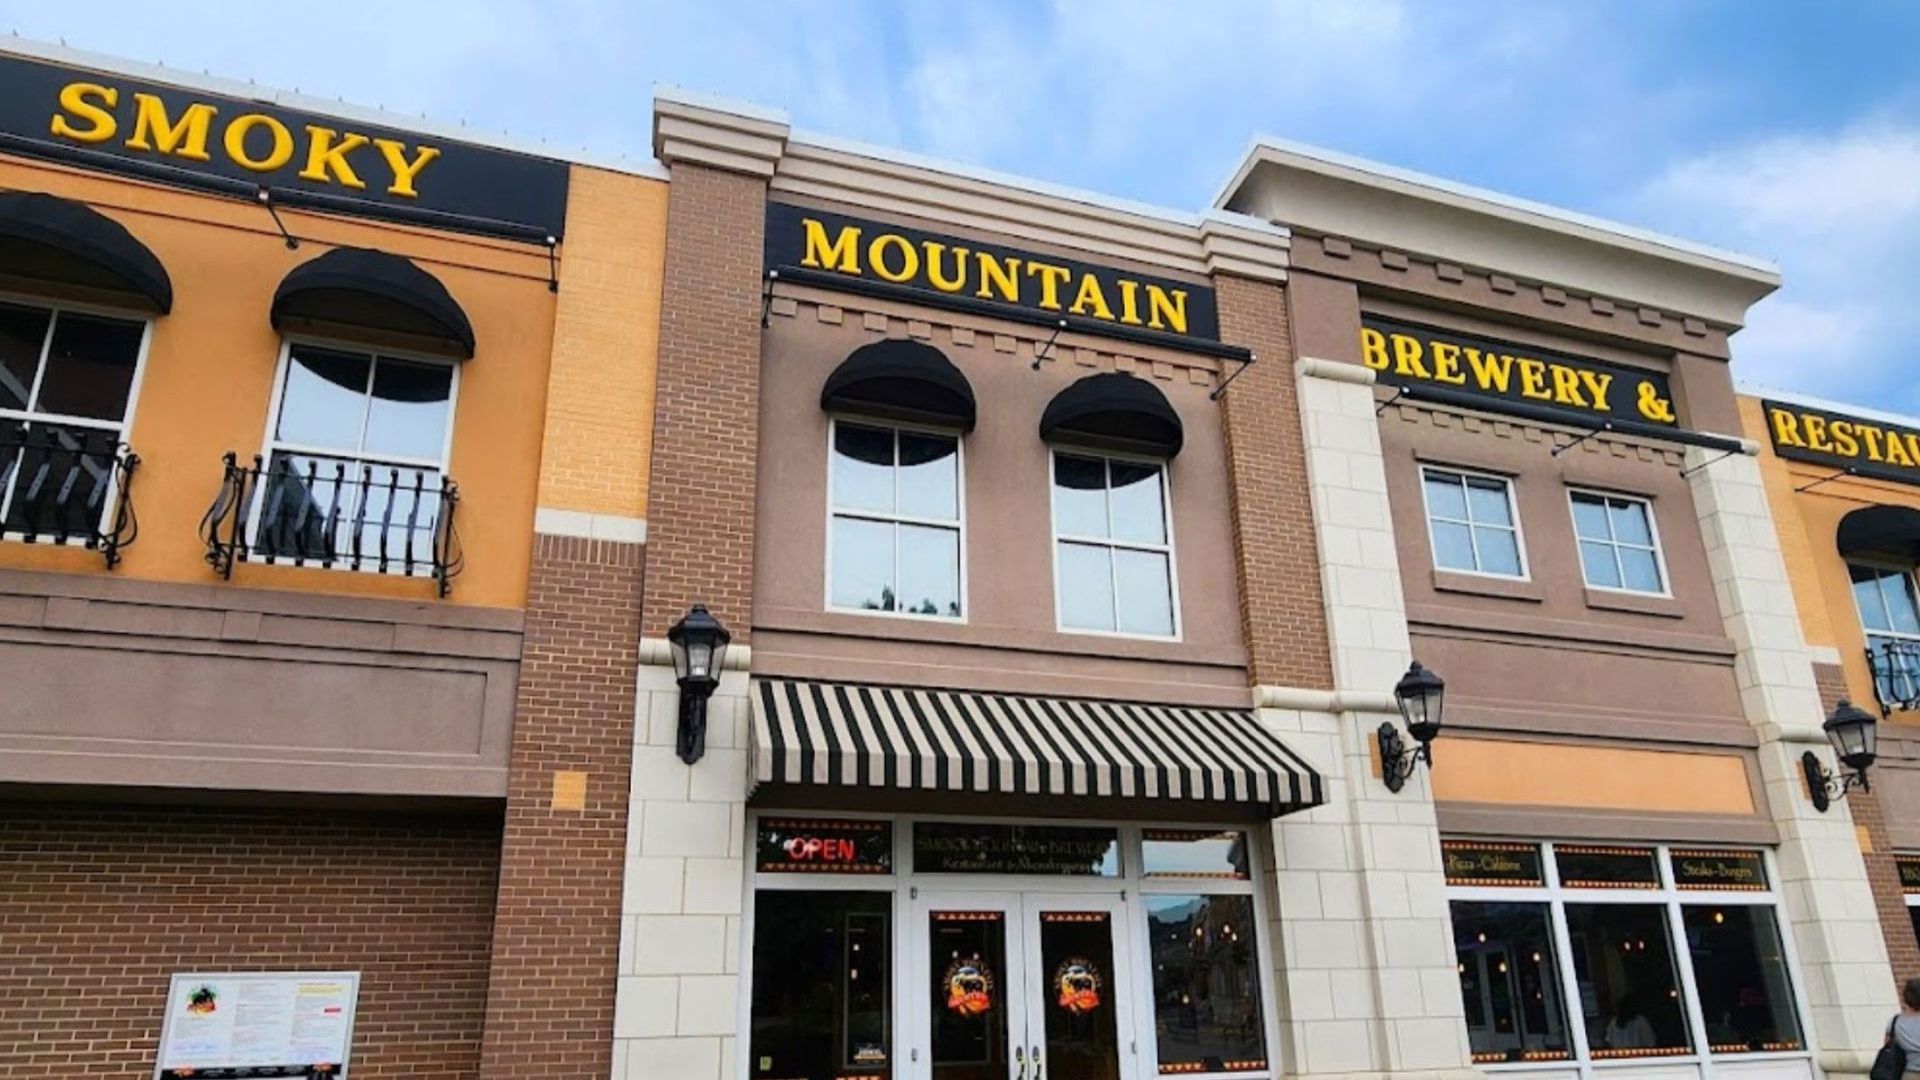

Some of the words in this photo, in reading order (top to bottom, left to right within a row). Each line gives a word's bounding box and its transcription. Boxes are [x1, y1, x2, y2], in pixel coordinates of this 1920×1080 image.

[51, 83, 440, 198] SMOKY
[802, 219, 1188, 334] MOUNTAIN
[1361, 327, 1612, 411] BREWERY
[1637, 380, 1675, 423] &
[789, 836, 854, 859] OPEN
